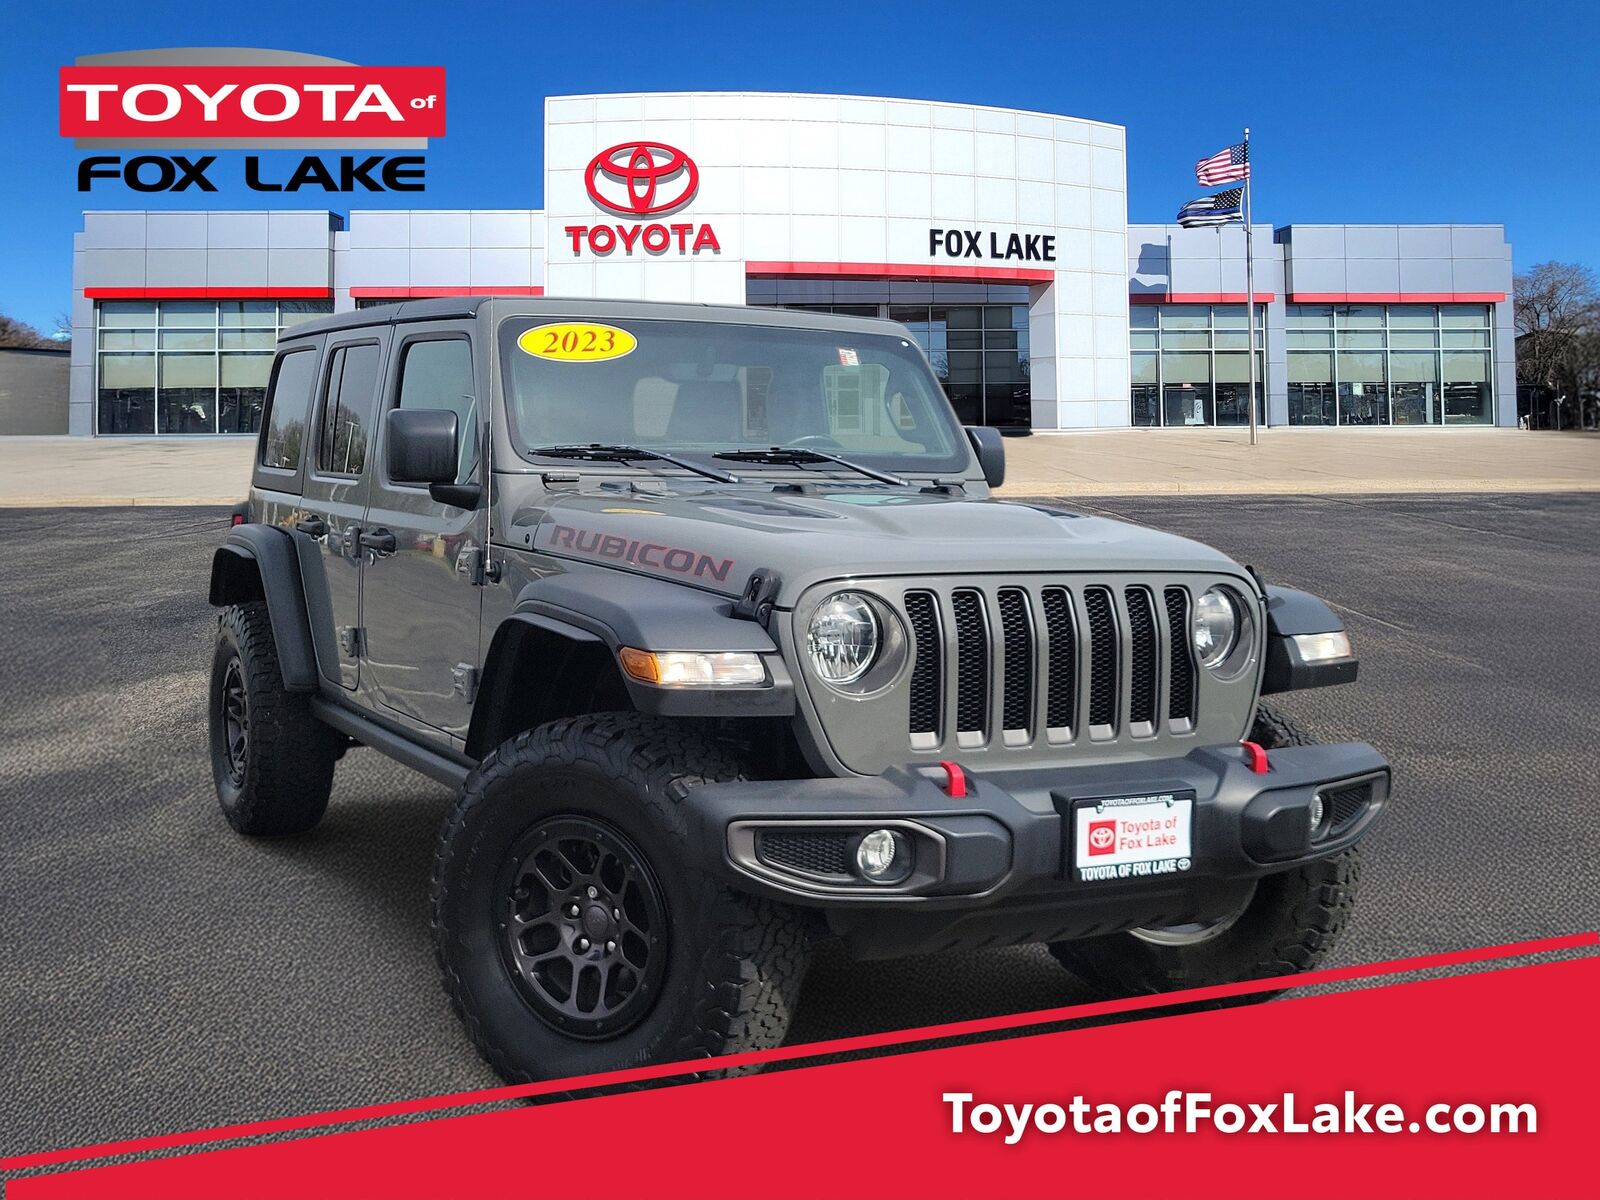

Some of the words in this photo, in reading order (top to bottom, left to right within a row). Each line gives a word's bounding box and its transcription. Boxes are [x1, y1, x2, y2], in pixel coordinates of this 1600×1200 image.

[565, 223, 720, 256] TOYOTA
[929, 228, 982, 258] FOX
[990, 231, 1056, 262] LAKE
[543, 330, 616, 353] 2023
[550, 524, 734, 582] RUBICON
[1120, 819, 1162, 835] Toyota
[1165, 816, 1178, 829] of
[1120, 837, 1143, 850] Fox
[1146, 833, 1177, 847] Lake
[1081, 867, 1118, 881] TOYOTA
[1118, 864, 1131, 877] OF
[1133, 862, 1153, 876] FOX
[1153, 859, 1177, 874] LAKE
